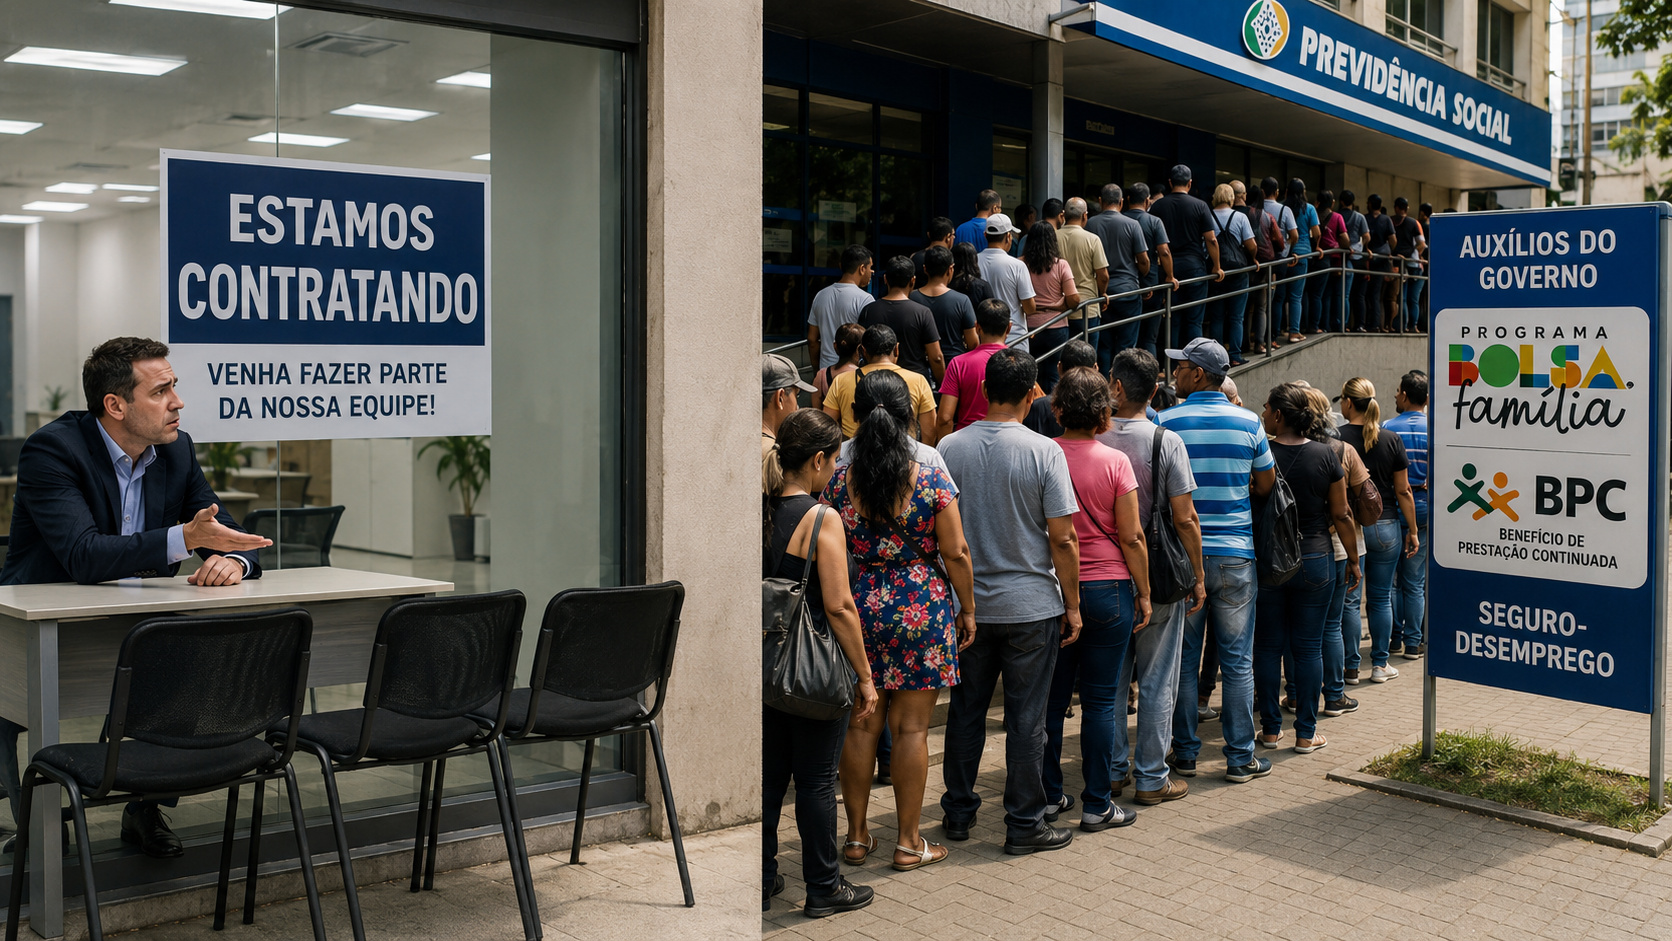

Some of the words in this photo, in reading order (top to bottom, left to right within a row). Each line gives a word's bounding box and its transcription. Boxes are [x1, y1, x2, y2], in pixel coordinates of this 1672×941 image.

[1299, 26, 1446, 120] PREVIDÊNCIA
[1452, 92, 1512, 145] SOCIAL
[230, 193, 435, 251] ESTAMOS
[1460, 228, 1570, 258] AUXÍLIOS
[1580, 229, 1616, 254] DO
[178, 262, 478, 324] CONTRATANDO
[1480, 264, 1598, 289] GOVERNO
[1461, 326, 1608, 339] PROGRAMA
[208, 363, 291, 386] VENHA
[300, 363, 371, 385] FAZER
[380, 362, 447, 384] PARTE
[219, 396, 252, 419] DA
[261, 395, 341, 419] NOSSA
[350, 394, 435, 420] EQUIPE!
[1453, 379, 1625, 434] família
[1535, 475, 1627, 522] BPC
[1500, 528, 1563, 545] BENEFÍCIO
[1568, 534, 1585, 548] DE
[1458, 541, 1528, 561] PRESTAÇÃO
[1532, 549, 1618, 569] CONTINUADA
[1479, 601, 1587, 637] SEGURO-
[1456, 630, 1615, 678] DESEMPREGO
